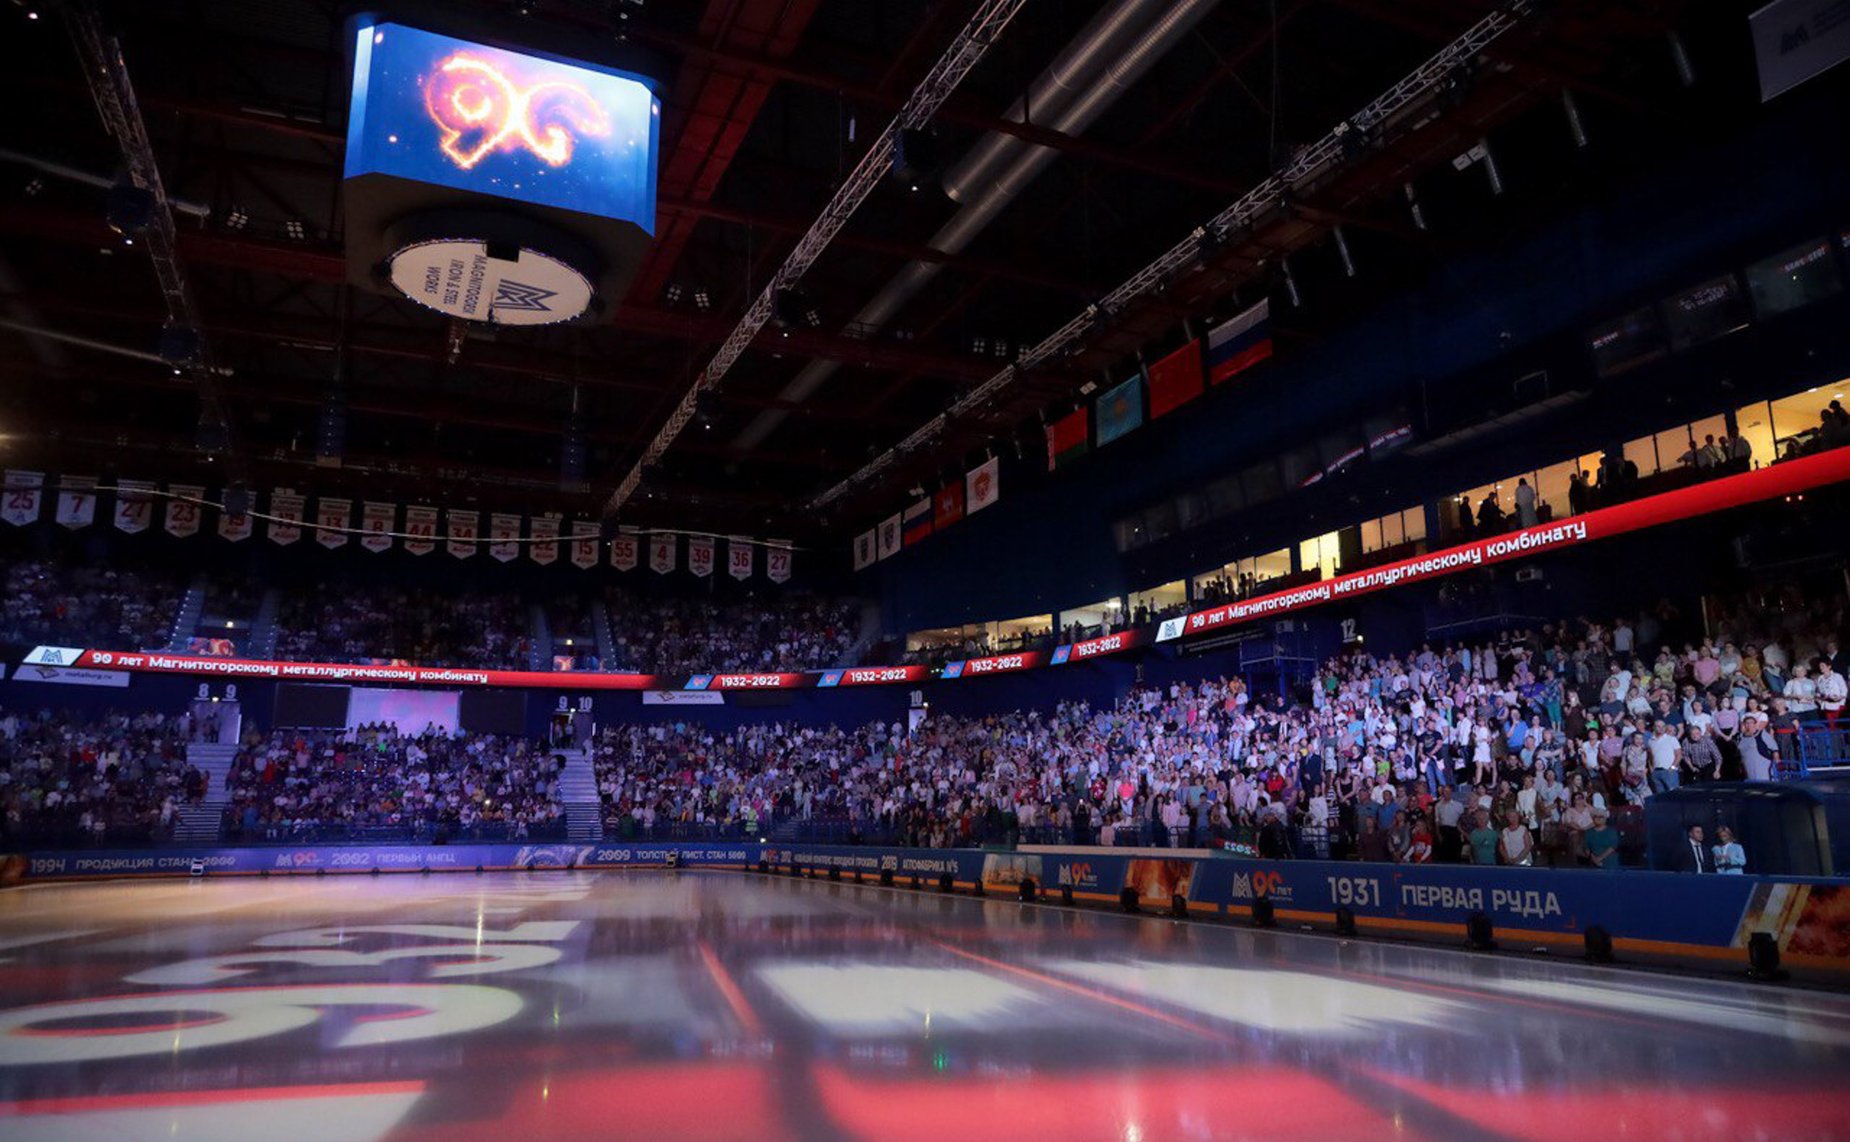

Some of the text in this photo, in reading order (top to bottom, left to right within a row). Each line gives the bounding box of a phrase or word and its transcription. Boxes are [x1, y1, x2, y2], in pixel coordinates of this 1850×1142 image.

[463, 254, 487, 315] MAGNITOGORSK
[9, 491, 34, 510] 25
[71, 496, 84, 513] 7
[172, 504, 195, 522] 23
[615, 542, 634, 558] 55
[657, 545, 667, 560] 4
[693, 549, 711, 564] 39
[770, 555, 787, 570] 27
[1191, 521, 1587, 629] 90 лет Магнитогорскому металлургическому комбинату
[1340, 618, 1357, 640] 12
[1077, 637, 1121, 656] 1932-2022
[92, 651, 488, 684] 90 лет Магнитогорскому металлургическому комбинату
[971, 656, 1023, 672] 1932-2022
[721, 675, 780, 687] 1932-2022
[851, 669, 907, 682] 1932-2022
[198, 683, 209, 698] 8
[225, 684, 237, 699] 9
[910, 690, 923, 705] 10
[558, 695, 568, 709] 9
[578, 696, 593, 709] 10
[331, 853, 370, 865] 2002
[597, 849, 631, 861] 2009
[31, 858, 66, 873] 1994
[76, 858, 154, 871] ПРОДУКЦИЯ
[1327, 876, 1380, 907] 1931
[1401, 885, 1562, 919] ПЕРВАЯ РУДА
